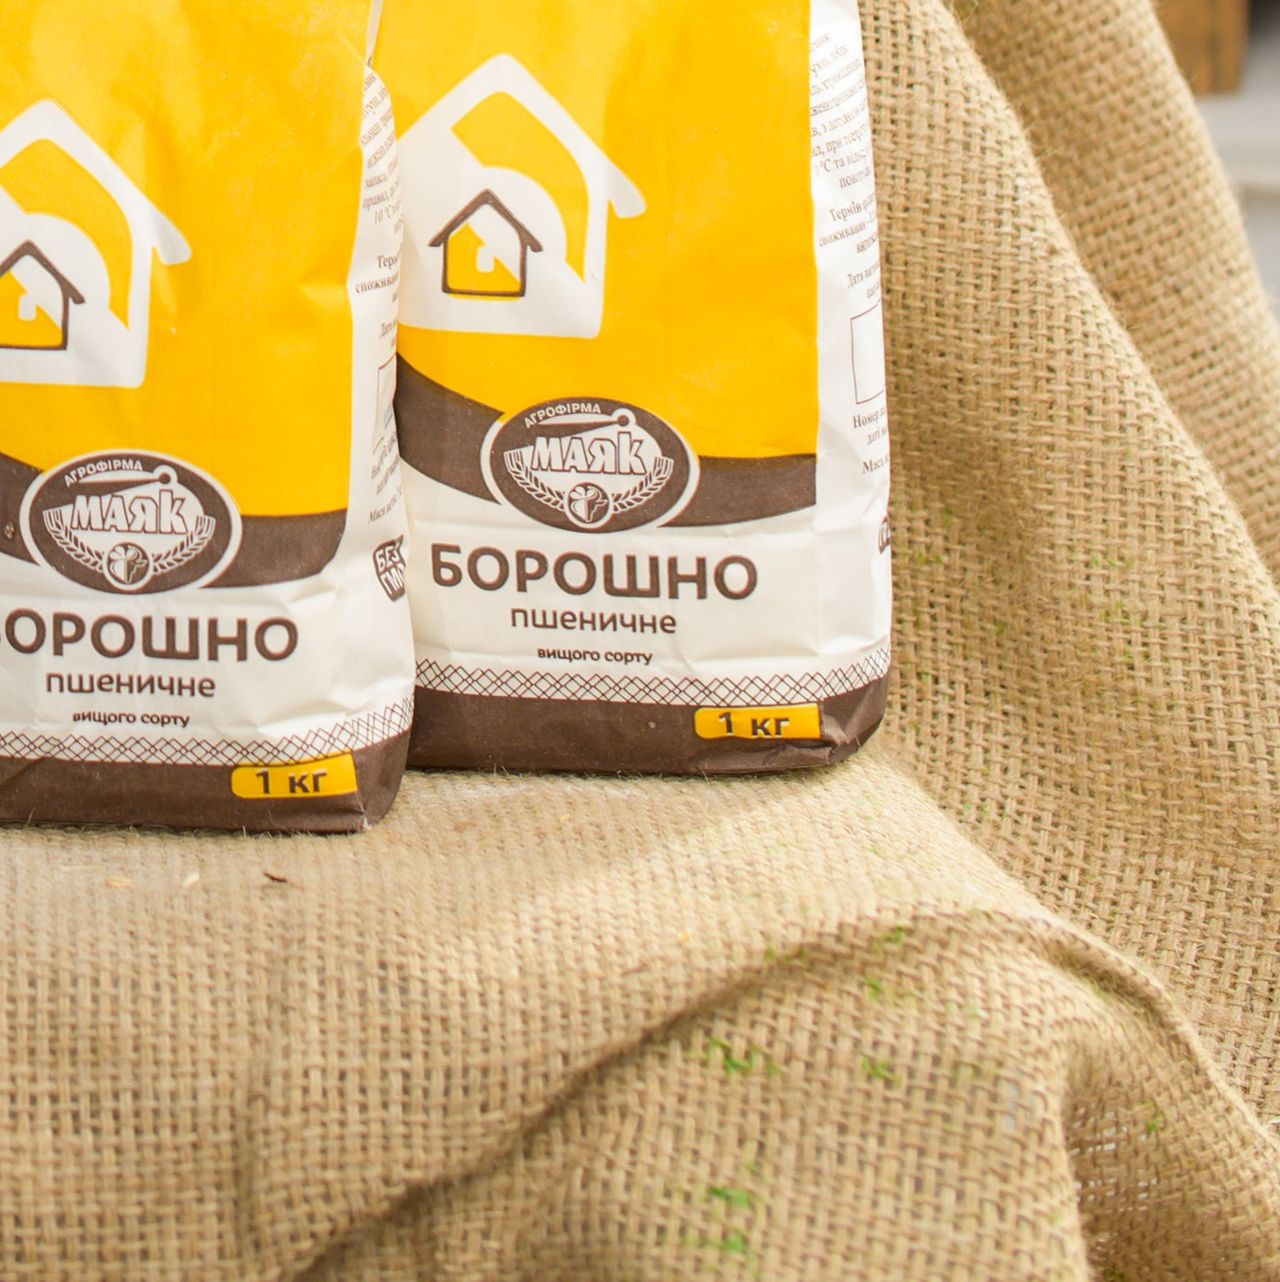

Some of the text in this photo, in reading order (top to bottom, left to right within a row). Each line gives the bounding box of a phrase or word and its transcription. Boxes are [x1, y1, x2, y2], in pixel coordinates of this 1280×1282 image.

[523, 402, 602, 428] АГРОФІРМА
[530, 431, 648, 476] МАЯК
[64, 458, 143, 487] АГРОФІРМА
[70, 490, 189, 535] МАЯК
[431, 543, 758, 601] БОРОШНО
[511, 607, 677, 635] пшеничне
[537, 646, 653, 666] вищого сорту
[45, 672, 217, 699] пшеничне
[72, 711, 190, 729] вищого сорту
[718, 712, 790, 738] 1 кг
[254, 769, 328, 795] 1 кг
